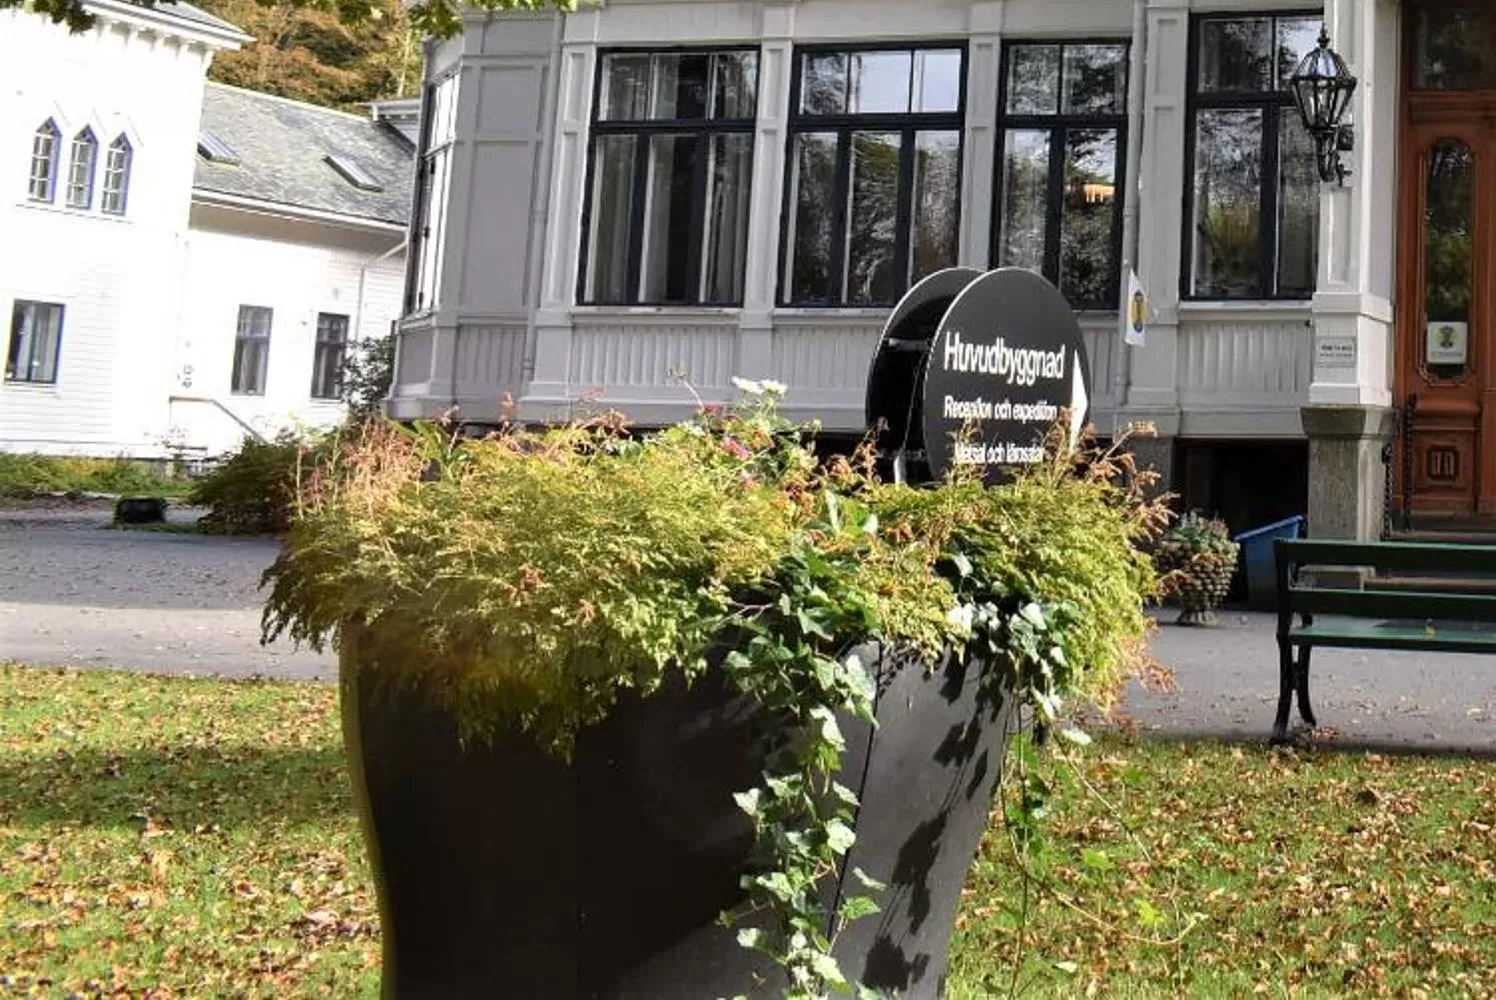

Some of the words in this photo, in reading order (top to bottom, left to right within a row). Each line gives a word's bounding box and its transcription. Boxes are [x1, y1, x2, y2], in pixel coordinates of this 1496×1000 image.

[943, 331, 1066, 387] Huvudbyggnad
[943, 395, 992, 422] Reception
[994, 399, 1012, 420] och
[1013, 400, 1058, 424] expedition
[986, 442, 1005, 464] och
